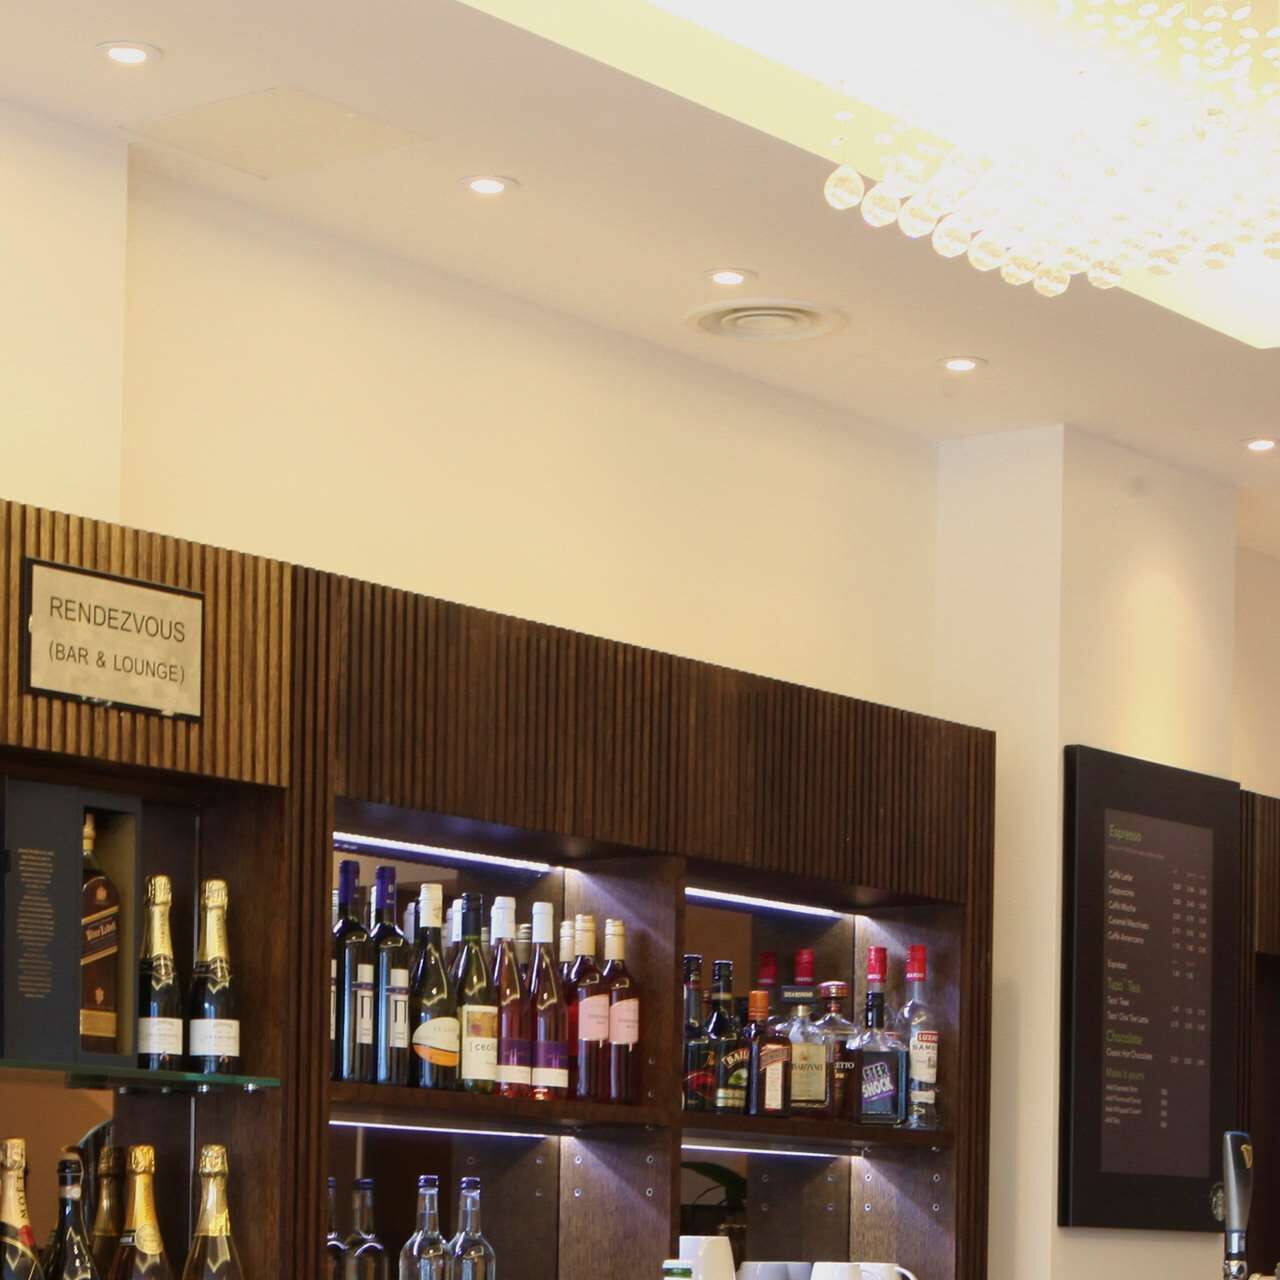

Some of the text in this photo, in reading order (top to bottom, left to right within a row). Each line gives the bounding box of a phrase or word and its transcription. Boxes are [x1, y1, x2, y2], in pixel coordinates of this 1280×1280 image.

[49, 596, 186, 643] RENDEZVOUS
[48, 639, 186, 687] (BAR & LOUNGE)
